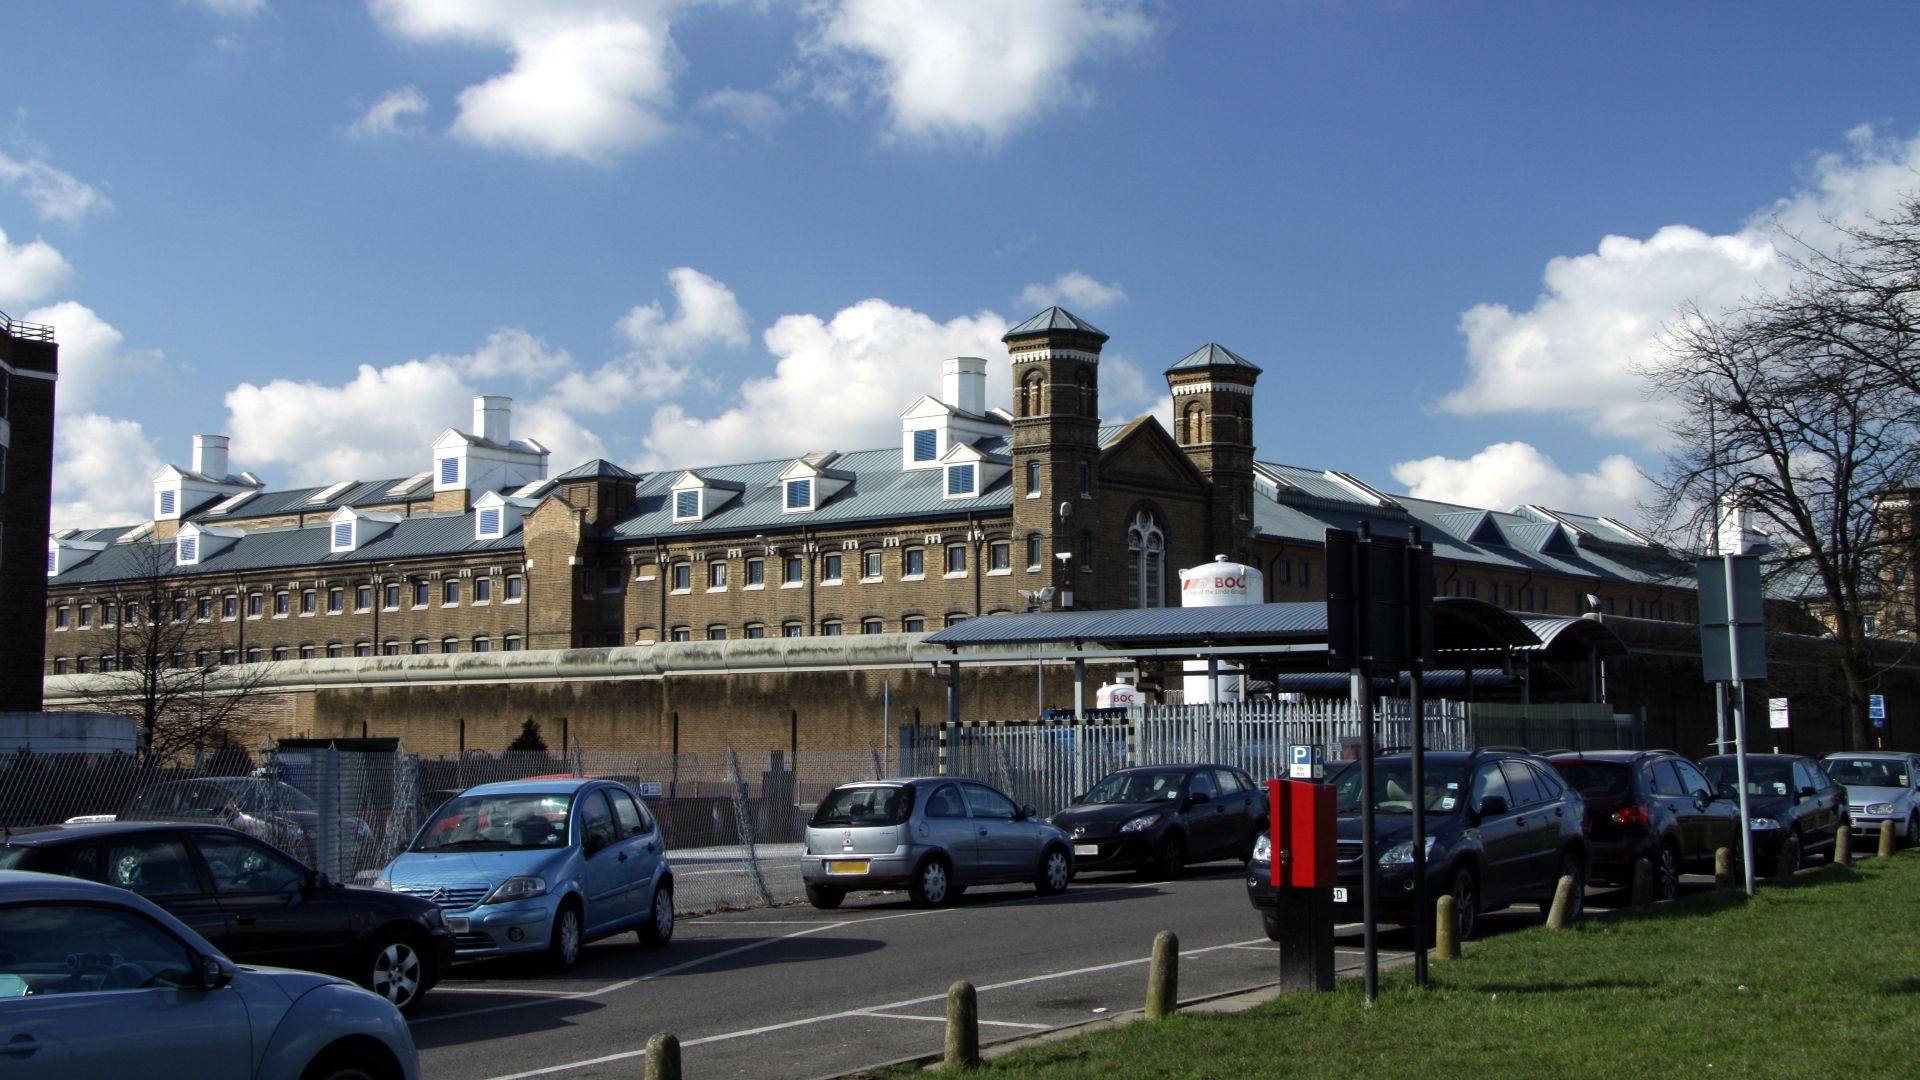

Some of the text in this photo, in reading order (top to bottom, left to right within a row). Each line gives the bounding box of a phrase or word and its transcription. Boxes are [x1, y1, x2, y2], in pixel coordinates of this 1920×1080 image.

[1215, 576, 1246, 588] BOC
[1113, 694, 1134, 702] BOC
[1294, 747, 1307, 764] P
[1315, 747, 1322, 764] P
